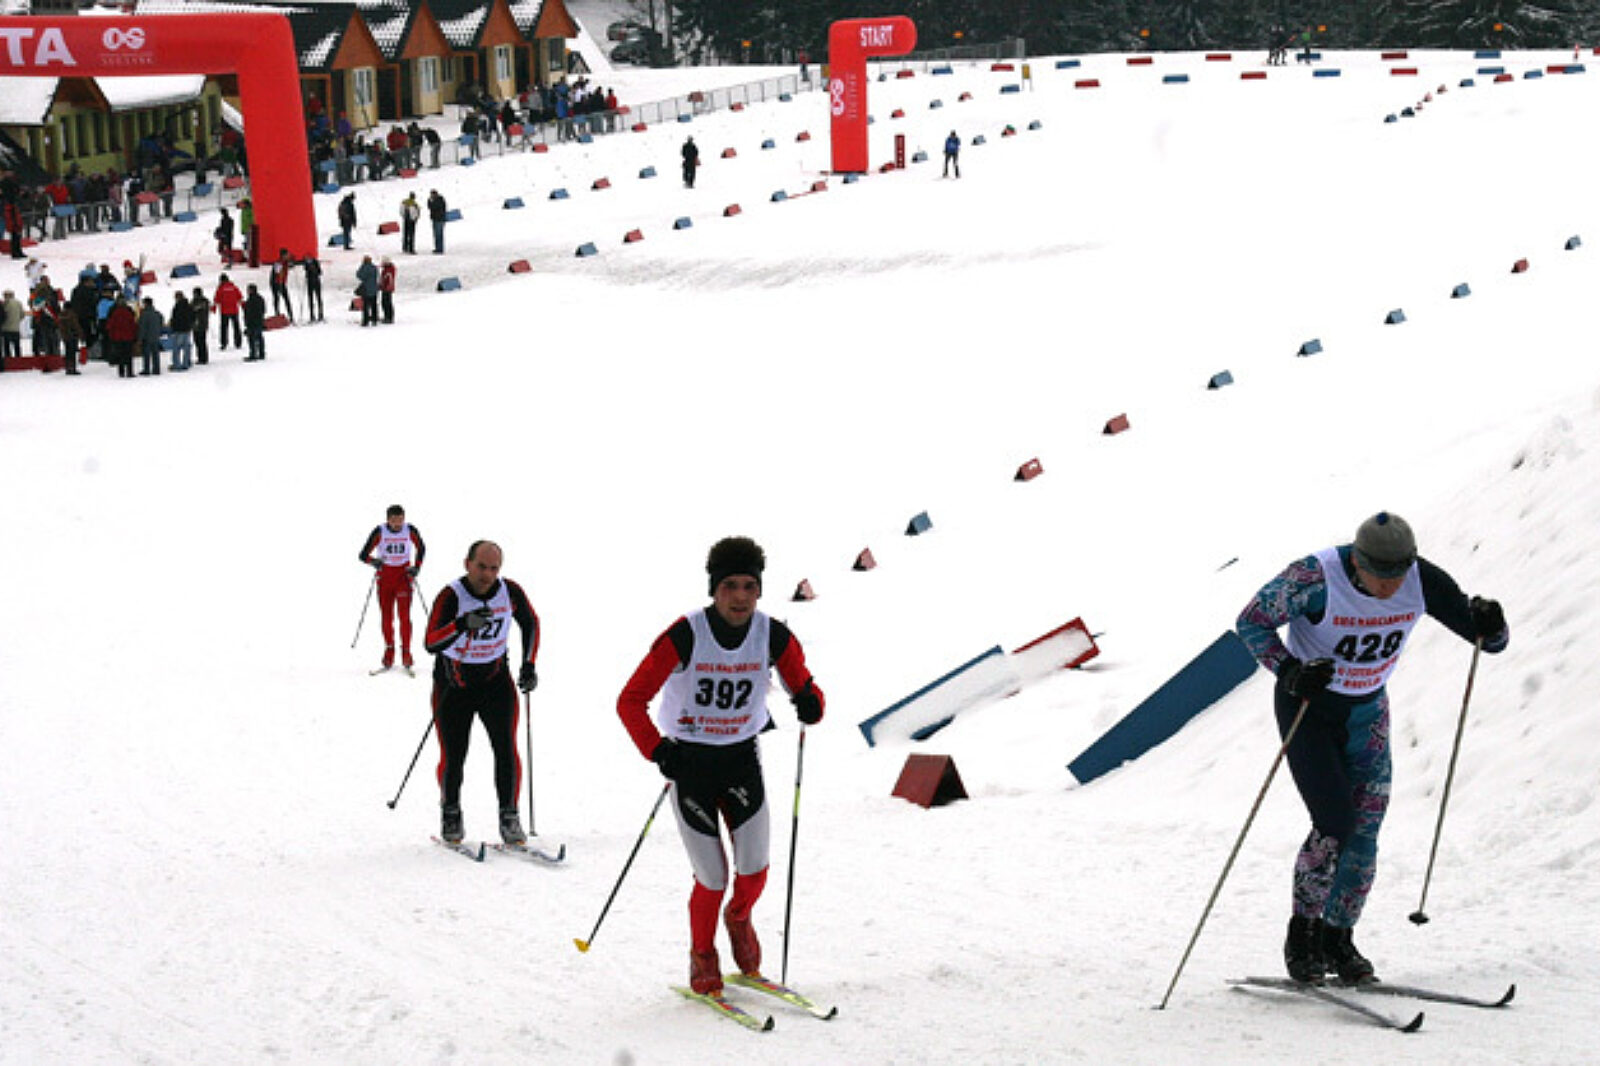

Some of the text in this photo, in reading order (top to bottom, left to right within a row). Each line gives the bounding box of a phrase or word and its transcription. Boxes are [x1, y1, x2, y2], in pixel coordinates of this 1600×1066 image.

[0, 27, 77, 66] TA
[860, 25, 893, 46] START
[695, 678, 753, 710] 392
